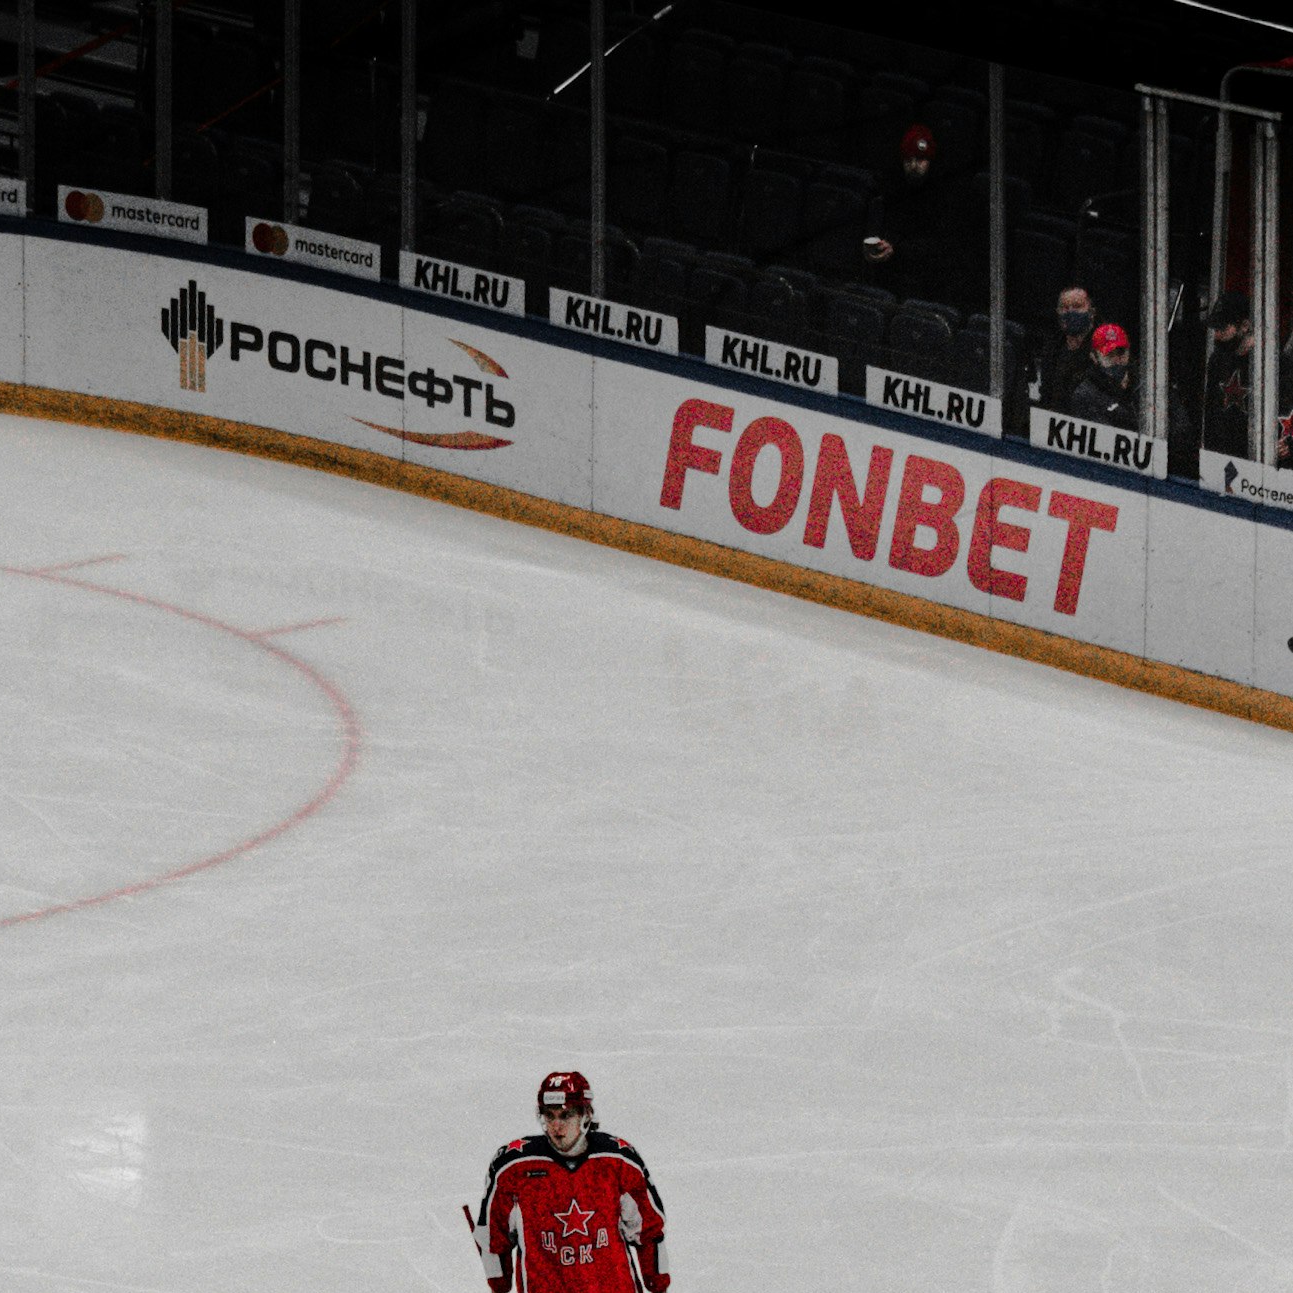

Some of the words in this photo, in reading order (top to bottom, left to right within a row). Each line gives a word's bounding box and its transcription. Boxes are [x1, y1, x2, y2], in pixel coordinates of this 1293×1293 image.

[111, 203, 200, 231] mastercard
[295, 238, 373, 268] mastercard
[413, 258, 511, 309] KHL.RU
[565, 296, 663, 347] KHL.RU
[229, 321, 516, 428] РОСНЕФТЬ
[721, 334, 823, 387] KHL.RU
[881, 375, 986, 430] KHL.RU
[1046, 416, 1155, 472] KHL.RU
[659, 398, 1119, 616] FONBET
[541, 1227, 610, 1267] ЦСКА
